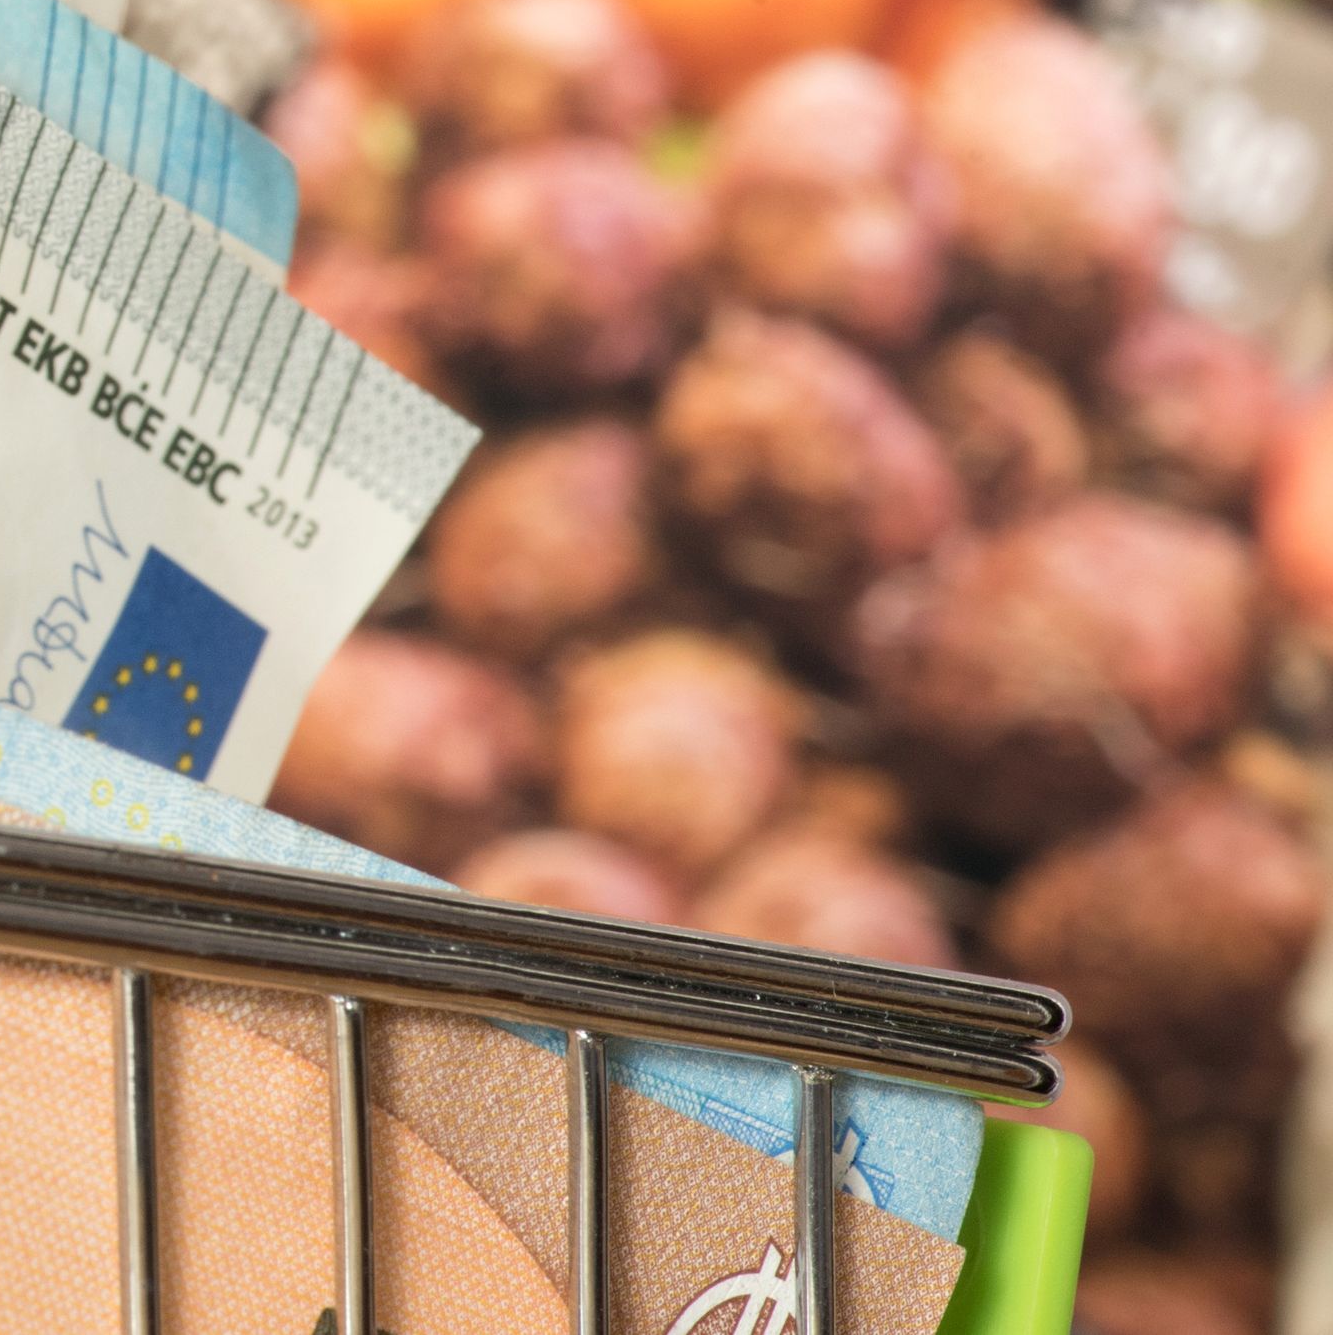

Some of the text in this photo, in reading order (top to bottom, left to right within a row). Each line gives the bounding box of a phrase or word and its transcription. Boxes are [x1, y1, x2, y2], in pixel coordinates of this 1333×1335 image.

[12, 317, 90, 397] EKB
[161, 427, 243, 506] EBC
[245, 485, 321, 552] 2013
